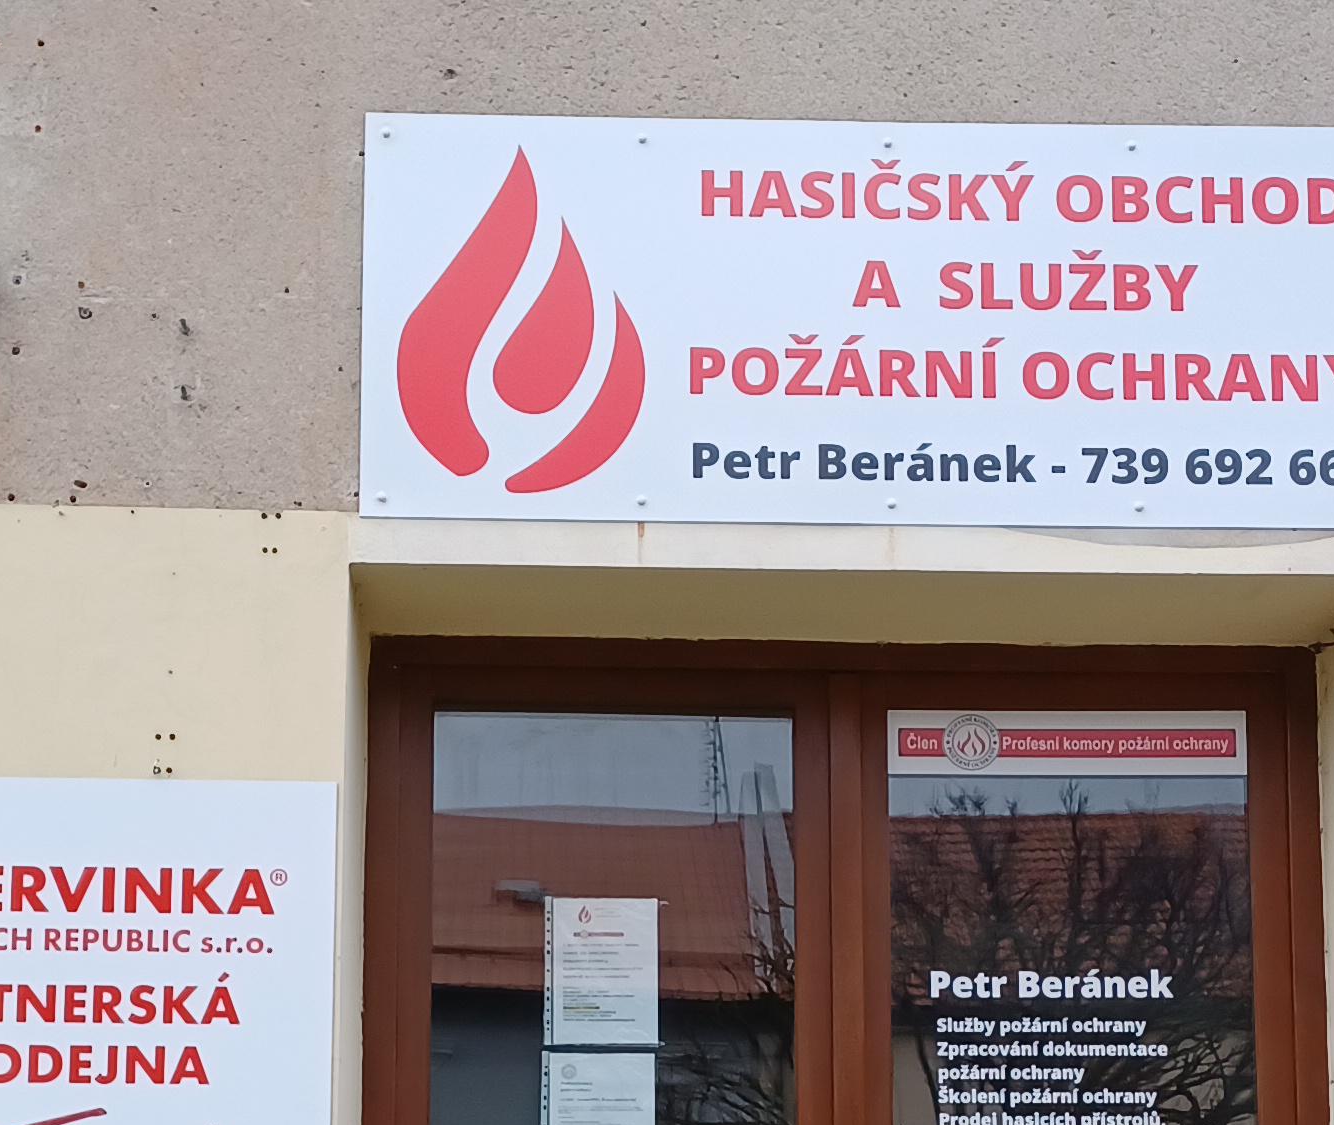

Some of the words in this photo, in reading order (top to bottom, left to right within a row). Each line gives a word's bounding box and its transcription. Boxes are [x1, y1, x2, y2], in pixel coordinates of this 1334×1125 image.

[701, 159, 1033, 222] HASIČSKÝ
[853, 260, 900, 308] A
[939, 250, 1198, 312] SLUŽBY
[690, 334, 1005, 400] POŽÁRNÍ
[691, 441, 800, 480] Petr
[817, 442, 1036, 485] Beránek
[1080, 446, 1168, 485] 739
[1186, 448, 1273, 486] 692
[906, 733, 938, 750] Člen
[1003, 736, 1059, 750] Profesní
[1063, 736, 1114, 754] komory
[1118, 736, 1169, 754] požární
[1173, 737, 1229, 754] ochrany
[44, 928, 191, 952] REPUBLIC
[200, 936, 273, 954] s.r.o.
[930, 970, 1008, 999] Petr
[1018, 968, 1174, 999] Beránek
[936, 1016, 996, 1037] Služby
[999, 1016, 1068, 1037] požární
[1072, 1018, 1147, 1037] ochrany
[936, 1041, 1040, 1060] Zpracování
[1042, 1041, 1168, 1057] dokumentace
[938, 1064, 1007, 1084] požární
[1010, 1065, 1085, 1084] ochrany
[938, 1086, 1006, 1105] Školení
[1010, 1088, 1078, 1107] požární
[1082, 1088, 1157, 1107] ochrany
